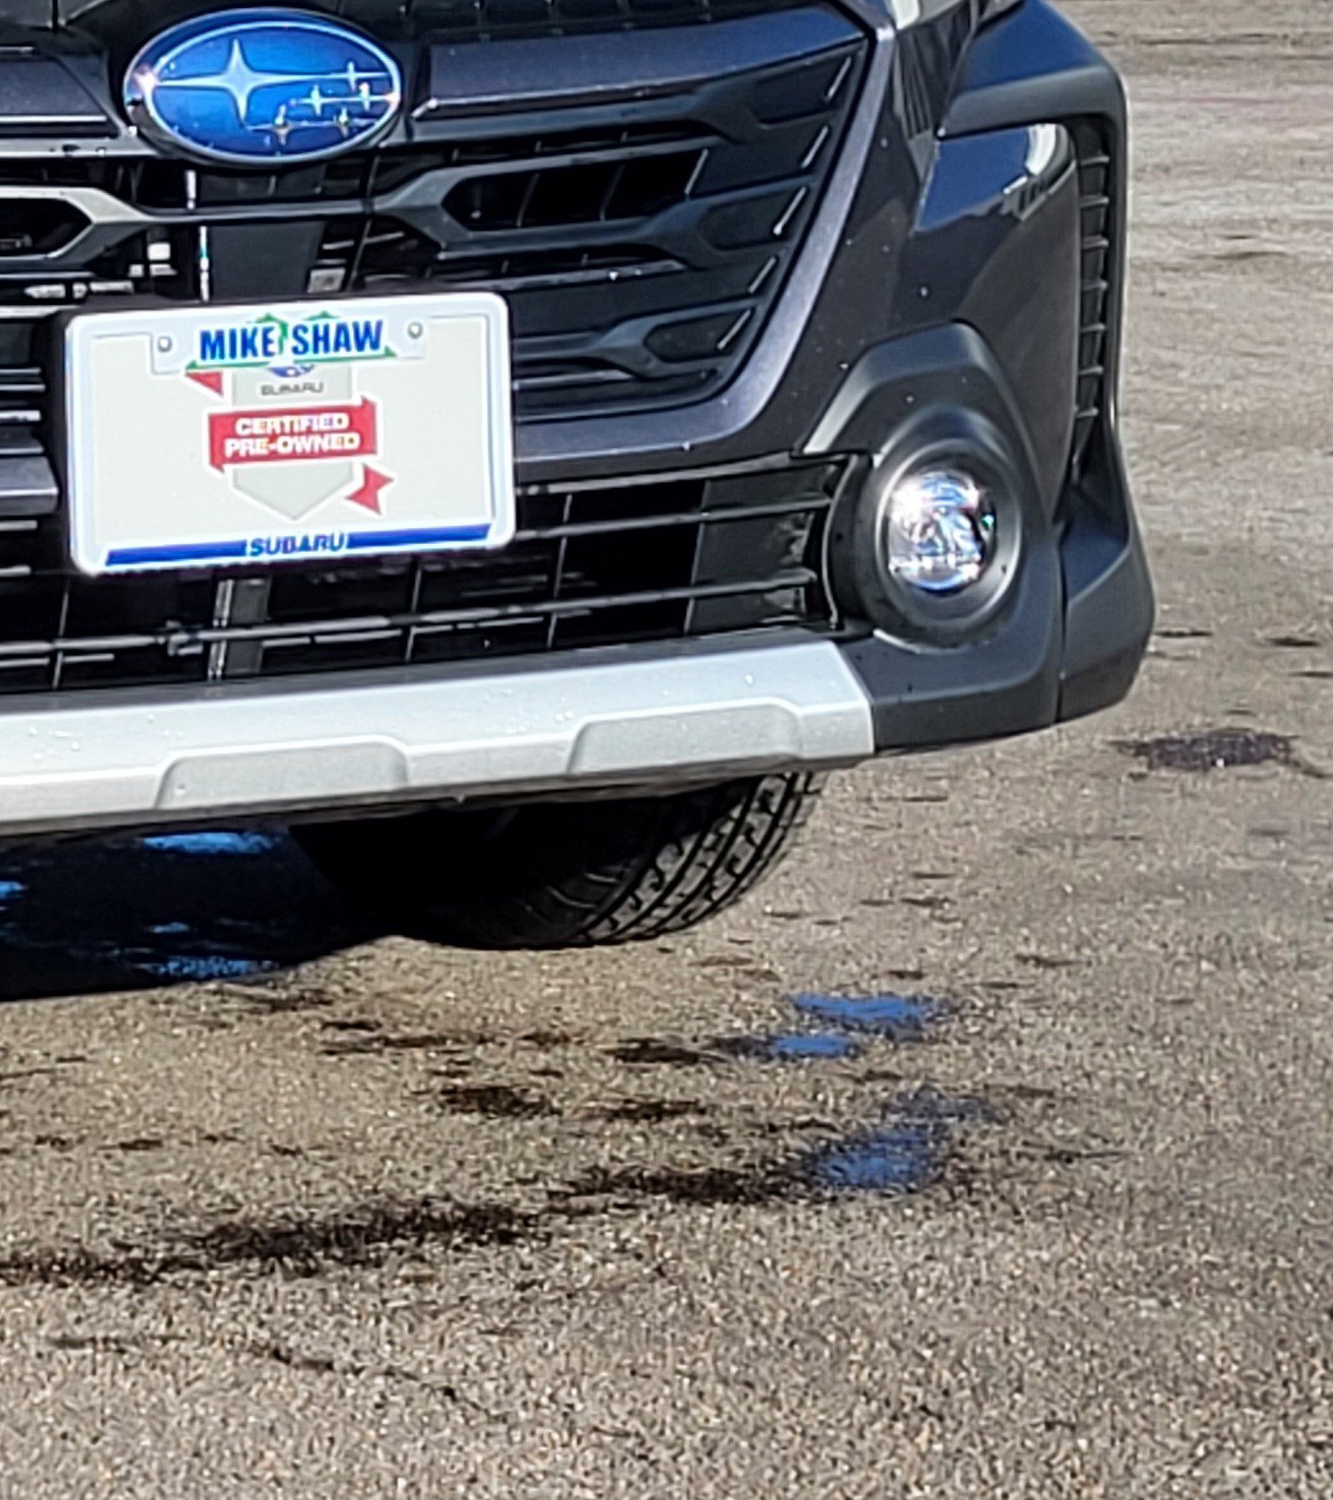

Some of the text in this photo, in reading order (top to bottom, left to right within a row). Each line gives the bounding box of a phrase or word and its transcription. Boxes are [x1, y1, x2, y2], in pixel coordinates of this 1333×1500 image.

[199, 319, 384, 361] MIKE SHAW
[260, 381, 324, 396] SUBARU
[235, 412, 350, 436] CERTIFIED
[223, 432, 361, 457] PRE-OWNED
[249, 531, 346, 557] SUBARU
